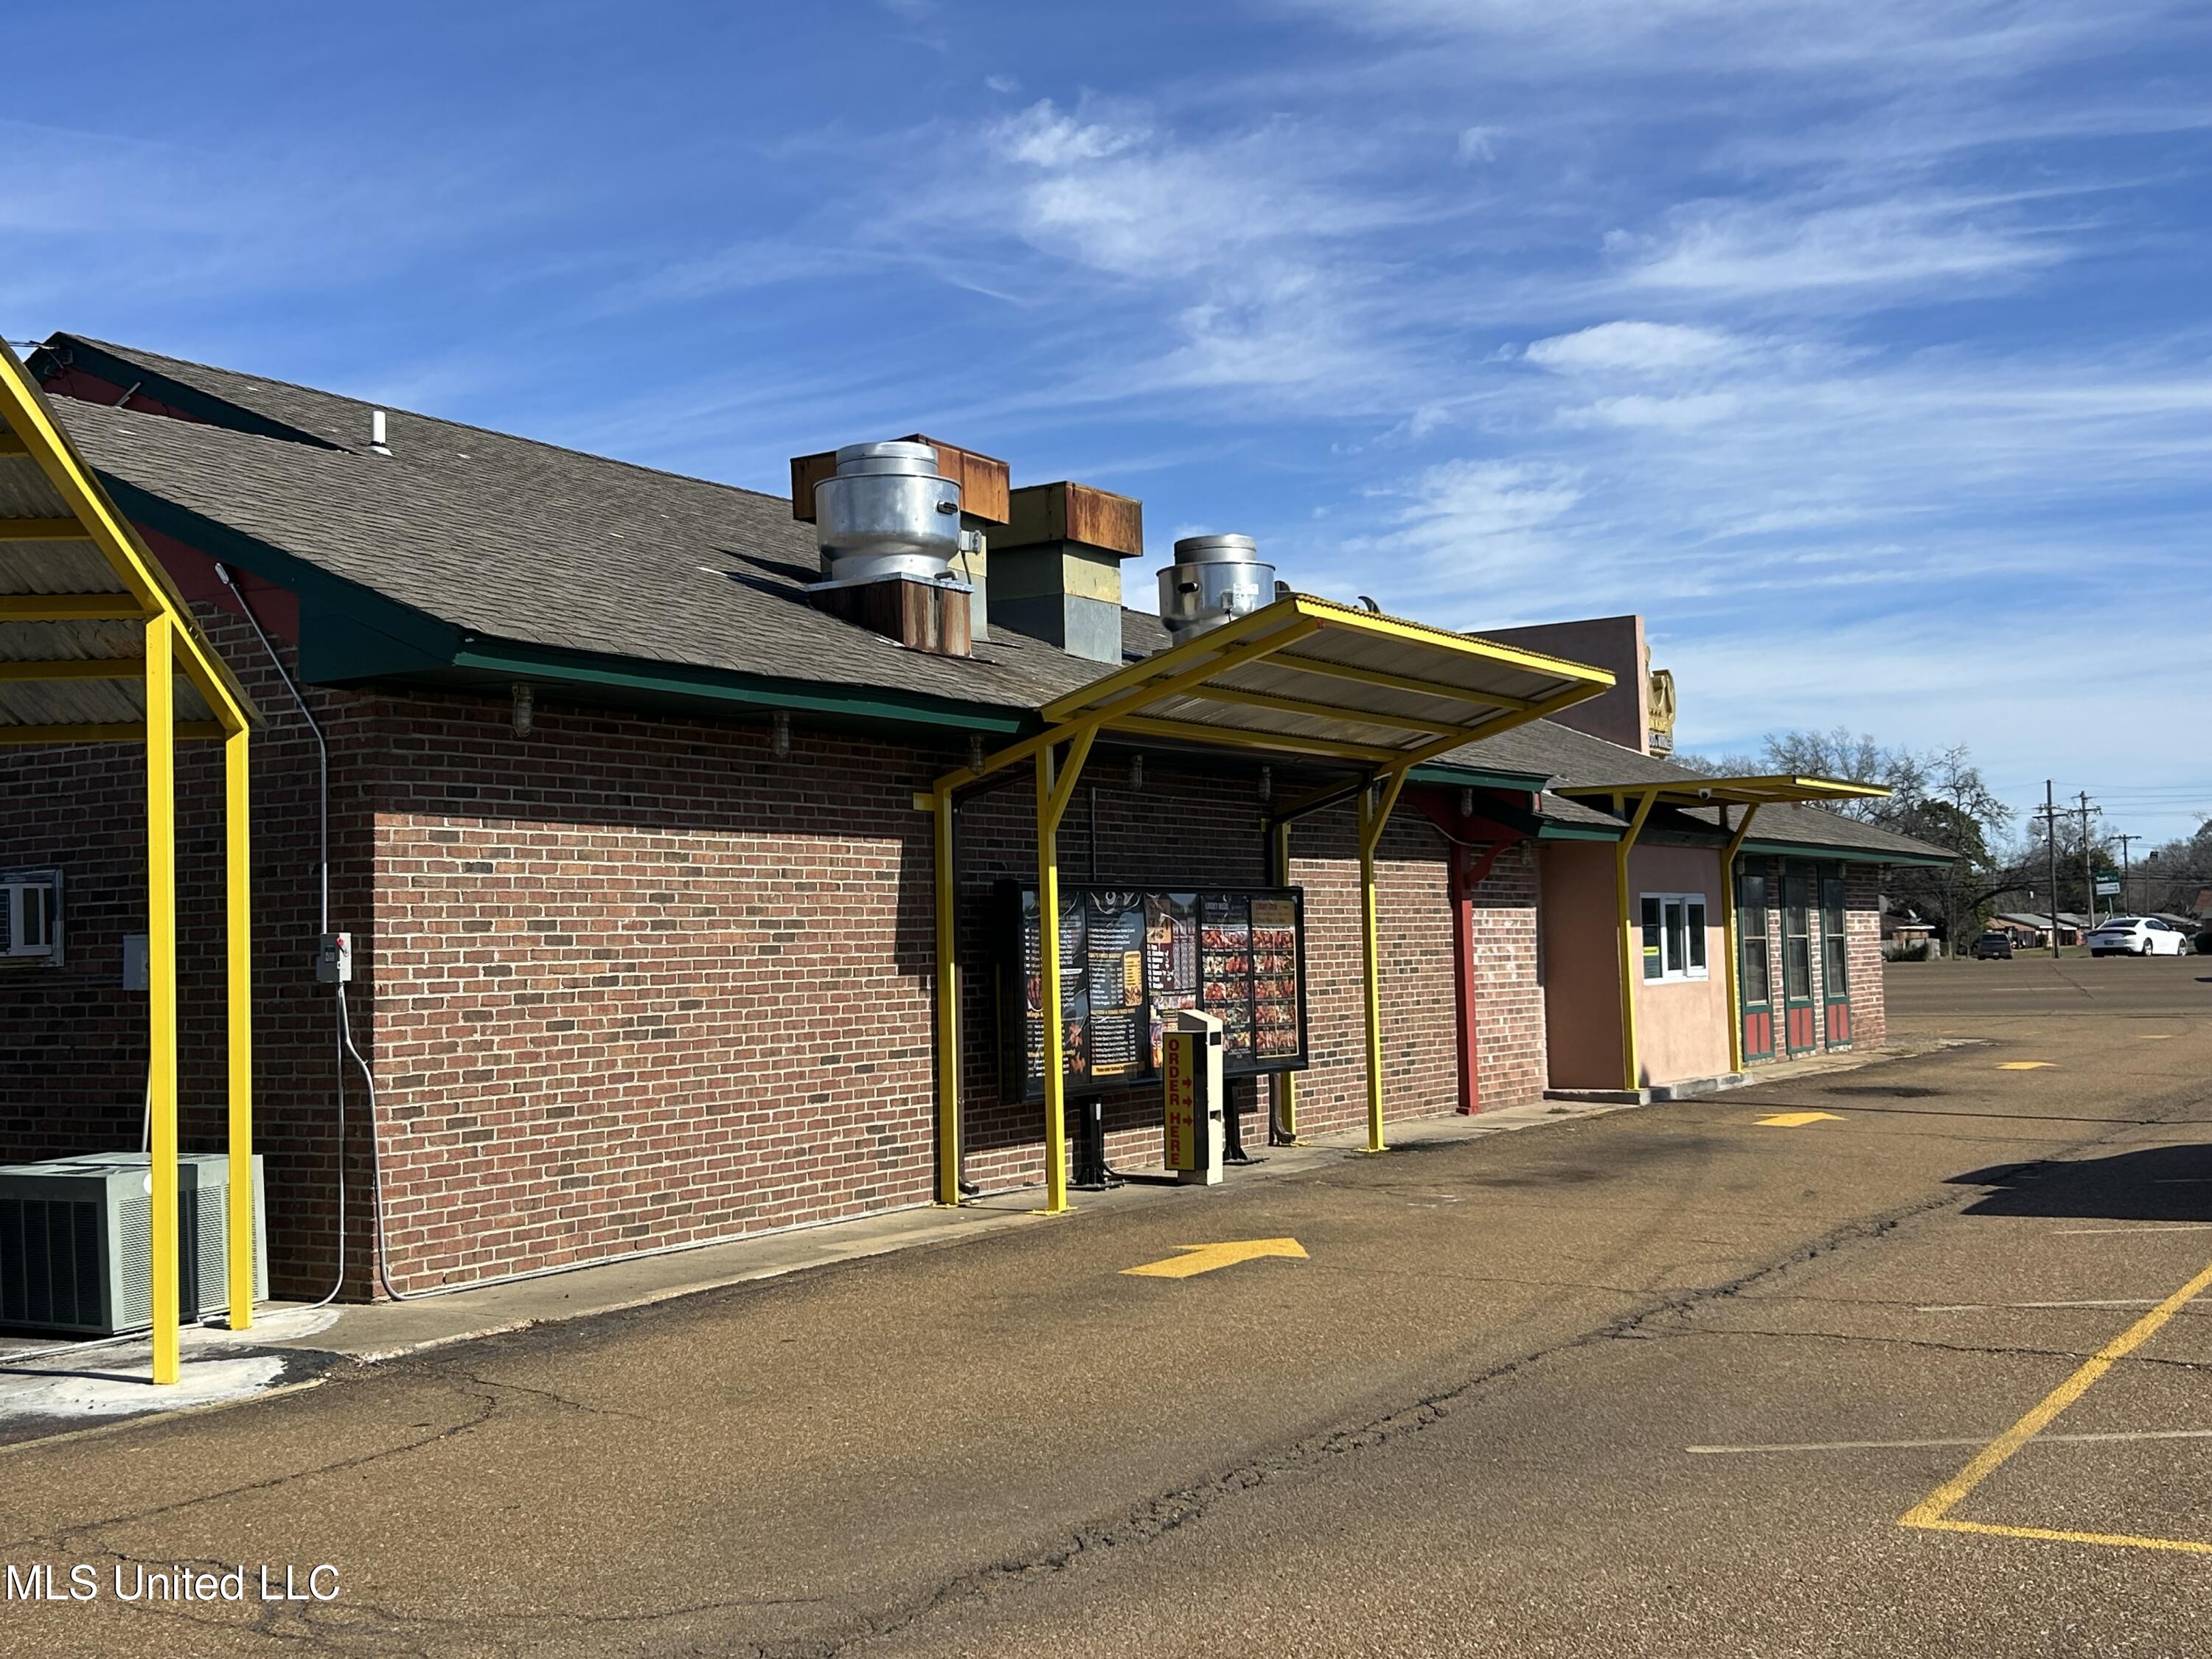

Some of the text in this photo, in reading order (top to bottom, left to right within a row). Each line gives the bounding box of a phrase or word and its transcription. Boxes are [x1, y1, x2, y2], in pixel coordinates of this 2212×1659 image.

[1169, 1039, 1180, 1105] ORDER
[1169, 1112, 1180, 1165] HERE
[6, 1564, 97, 1601] MLS
[114, 1564, 244, 1601] United
[260, 1564, 340, 1601] LLC
